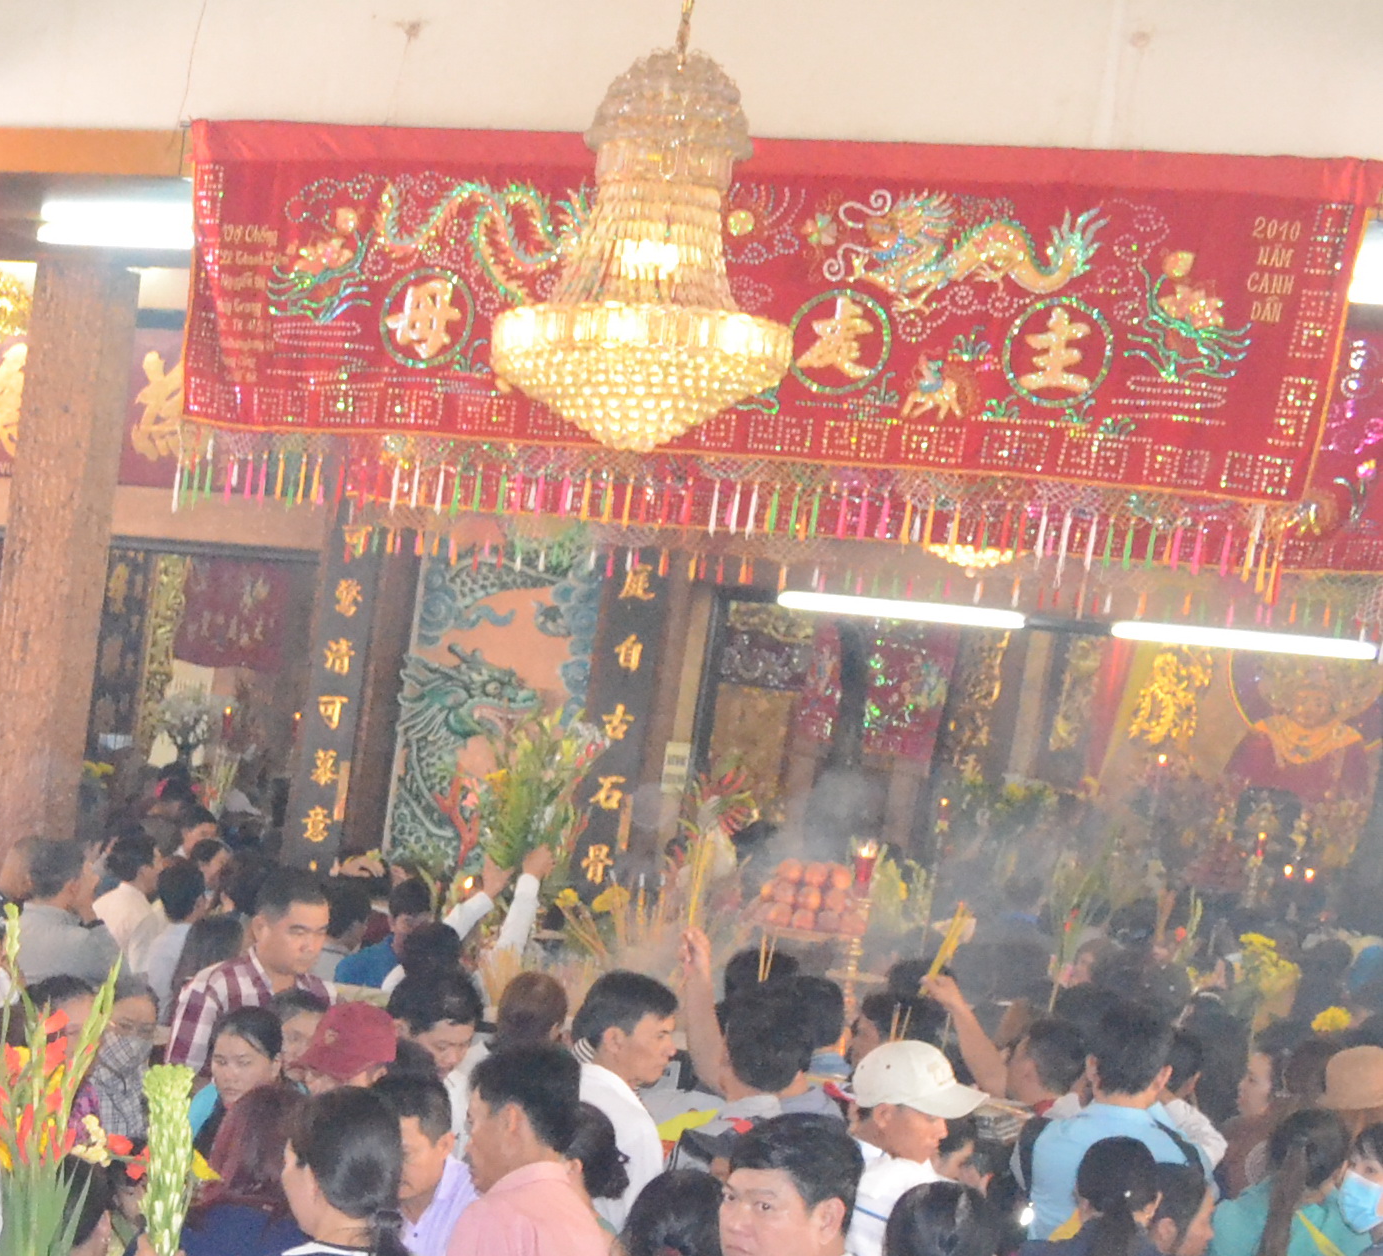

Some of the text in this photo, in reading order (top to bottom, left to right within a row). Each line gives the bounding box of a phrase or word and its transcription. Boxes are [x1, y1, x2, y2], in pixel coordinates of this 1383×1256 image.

[1252, 216, 1301, 241] 2010
[1257, 244, 1295, 268] NĂM
[1247, 272, 1295, 294] CANH
